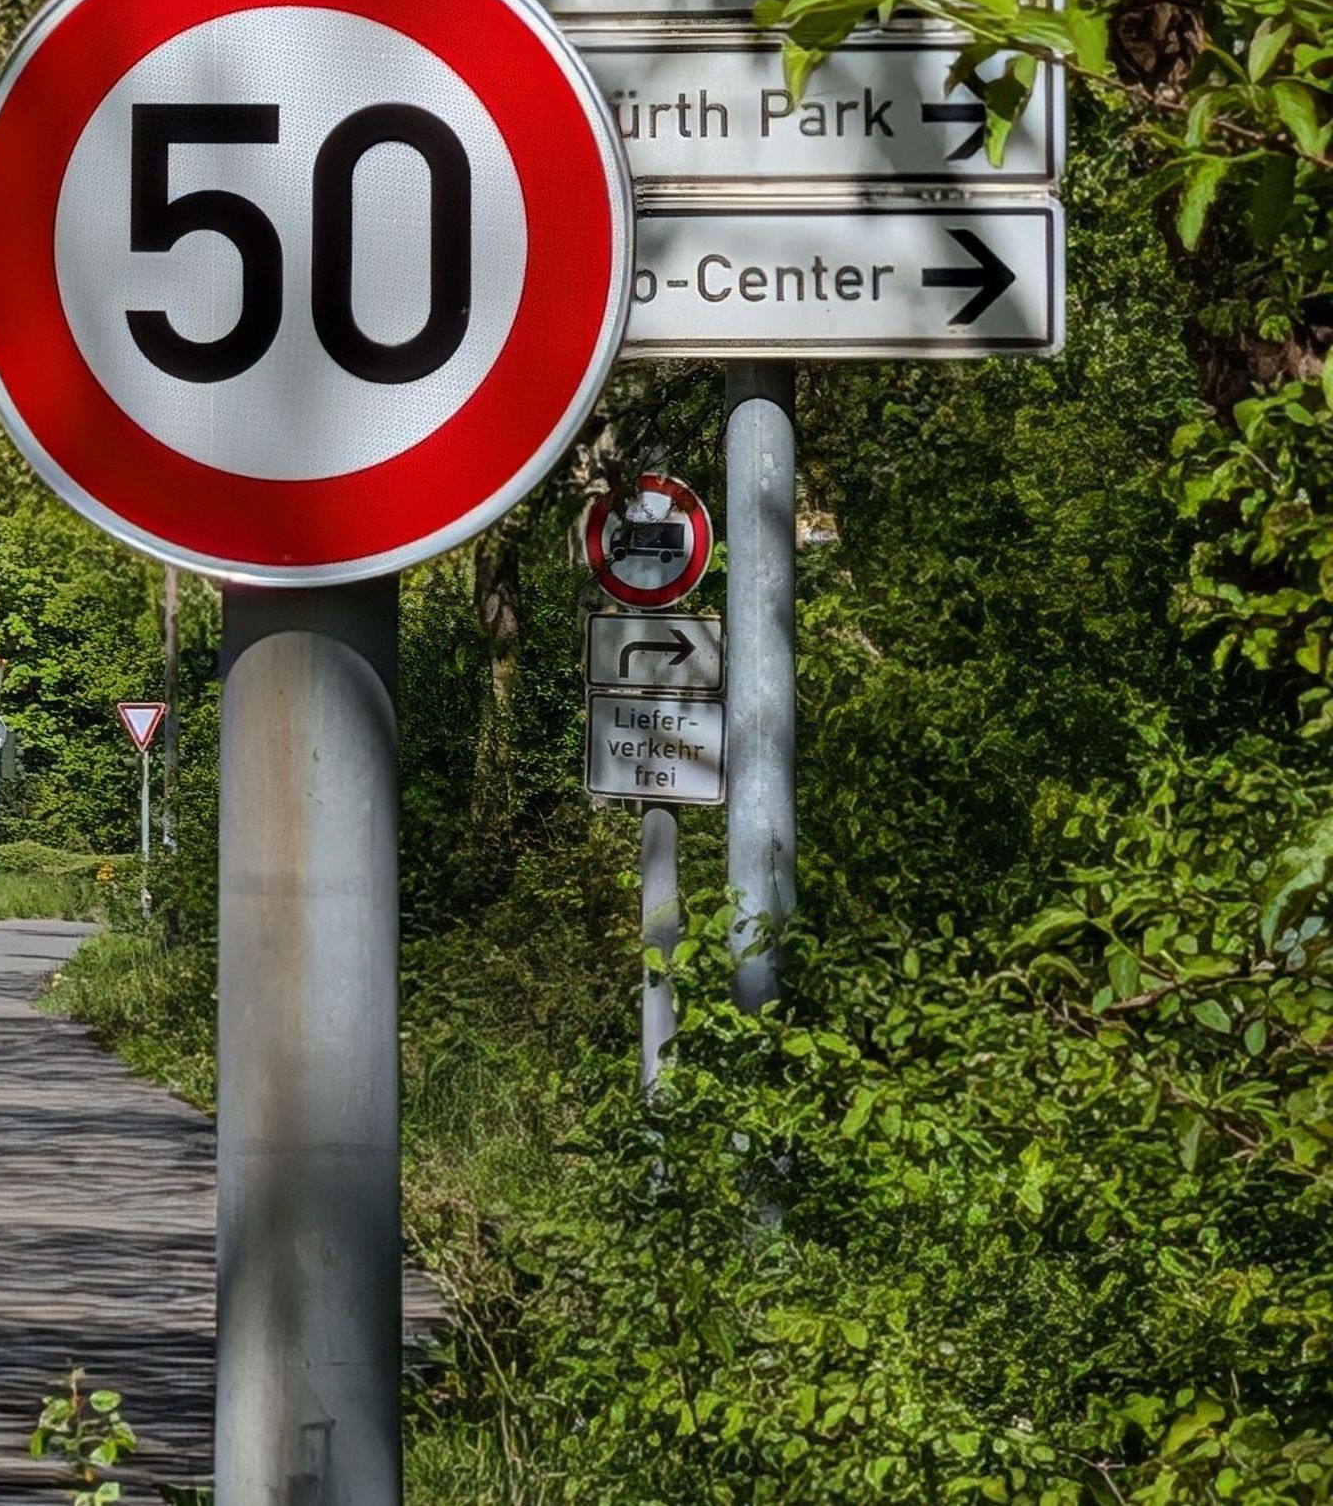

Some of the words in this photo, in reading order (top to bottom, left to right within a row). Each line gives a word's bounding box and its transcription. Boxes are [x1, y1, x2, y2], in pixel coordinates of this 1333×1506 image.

[760, 87, 895, 139] Park
[125, 102, 472, 385] 50
[614, 706, 700, 732] Liefer-
[606, 737, 706, 761] verkehr
[634, 764, 676, 788] frei
